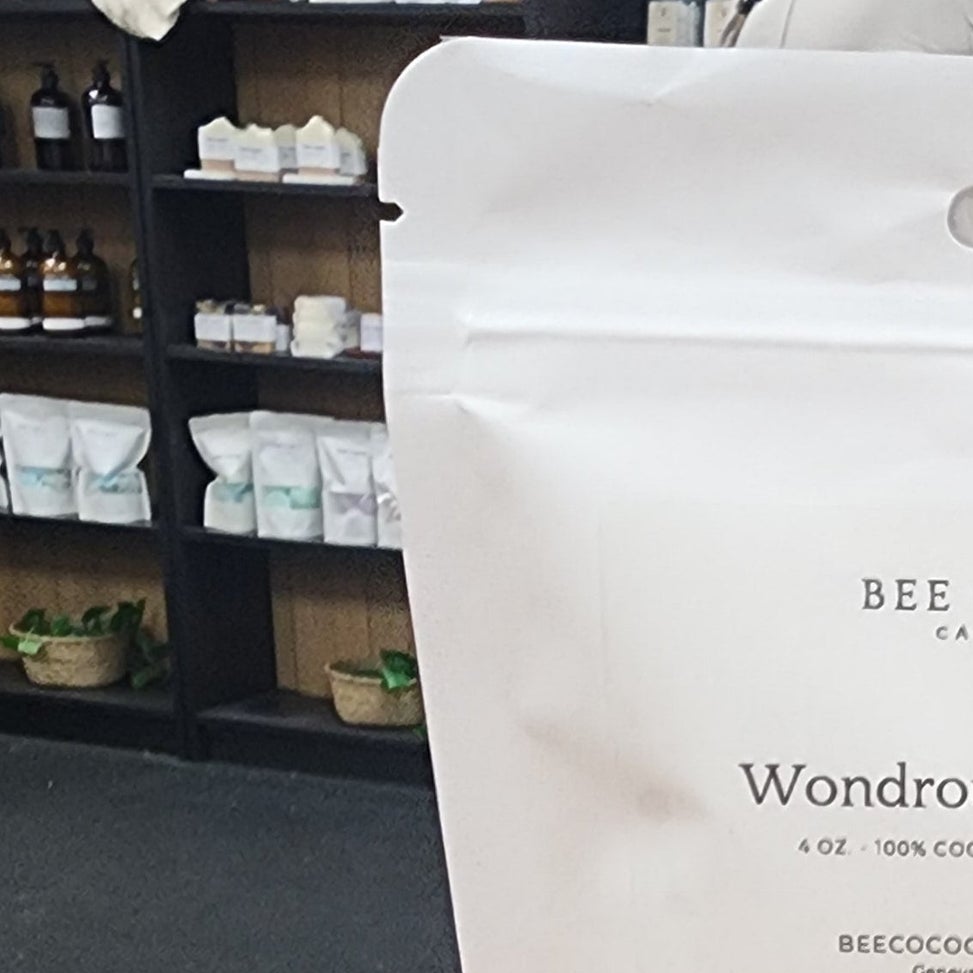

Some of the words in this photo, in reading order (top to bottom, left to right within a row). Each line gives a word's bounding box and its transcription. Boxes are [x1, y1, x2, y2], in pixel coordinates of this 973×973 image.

[860, 577, 951, 613] BEE
[798, 837, 811, 855] 4
[874, 838, 927, 858] 100%
